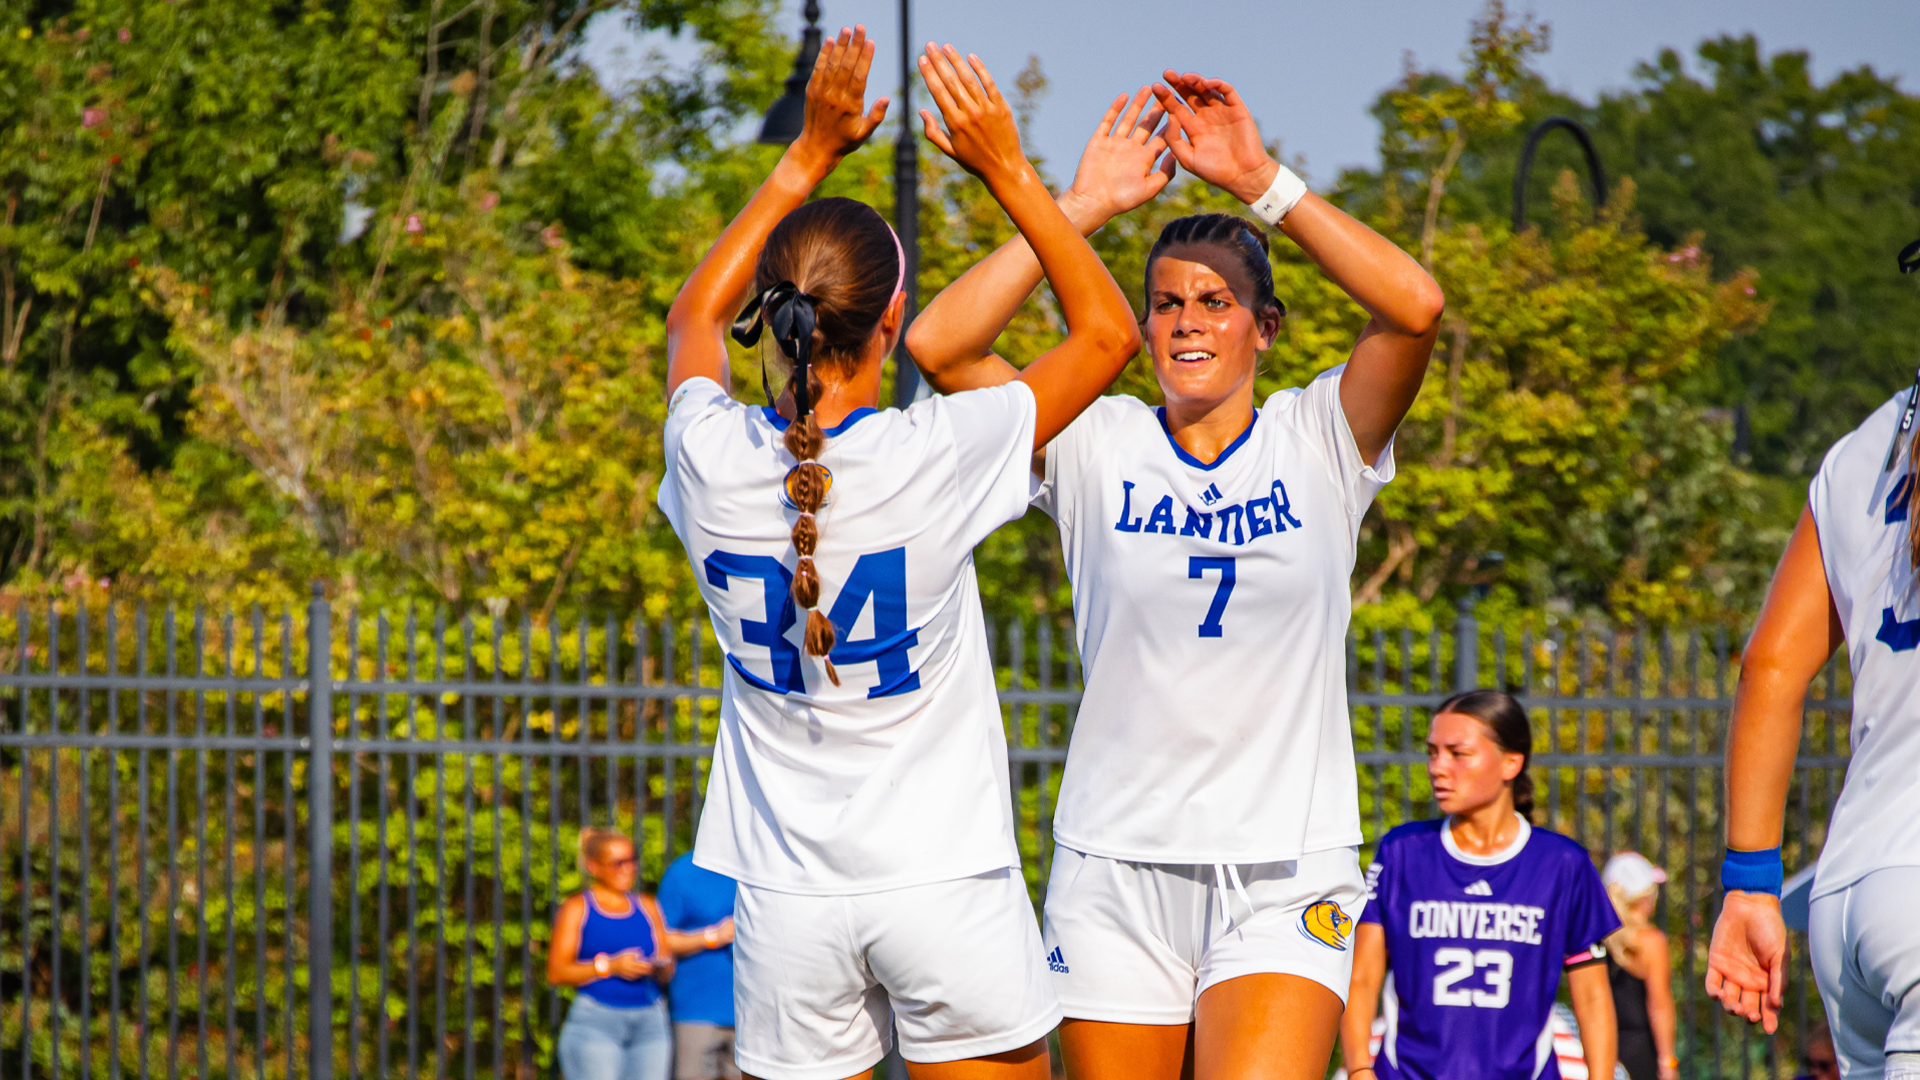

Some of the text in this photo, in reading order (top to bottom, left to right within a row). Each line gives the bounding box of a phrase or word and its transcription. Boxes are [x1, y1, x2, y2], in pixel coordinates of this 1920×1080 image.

[1114, 479, 1302, 545] LANDER
[703, 546, 921, 699] 34
[1188, 556, 1236, 637] 7
[1409, 901, 1545, 945] CONVERSE
[1049, 961, 1070, 974] idas
[1433, 948, 1513, 1008] 23
